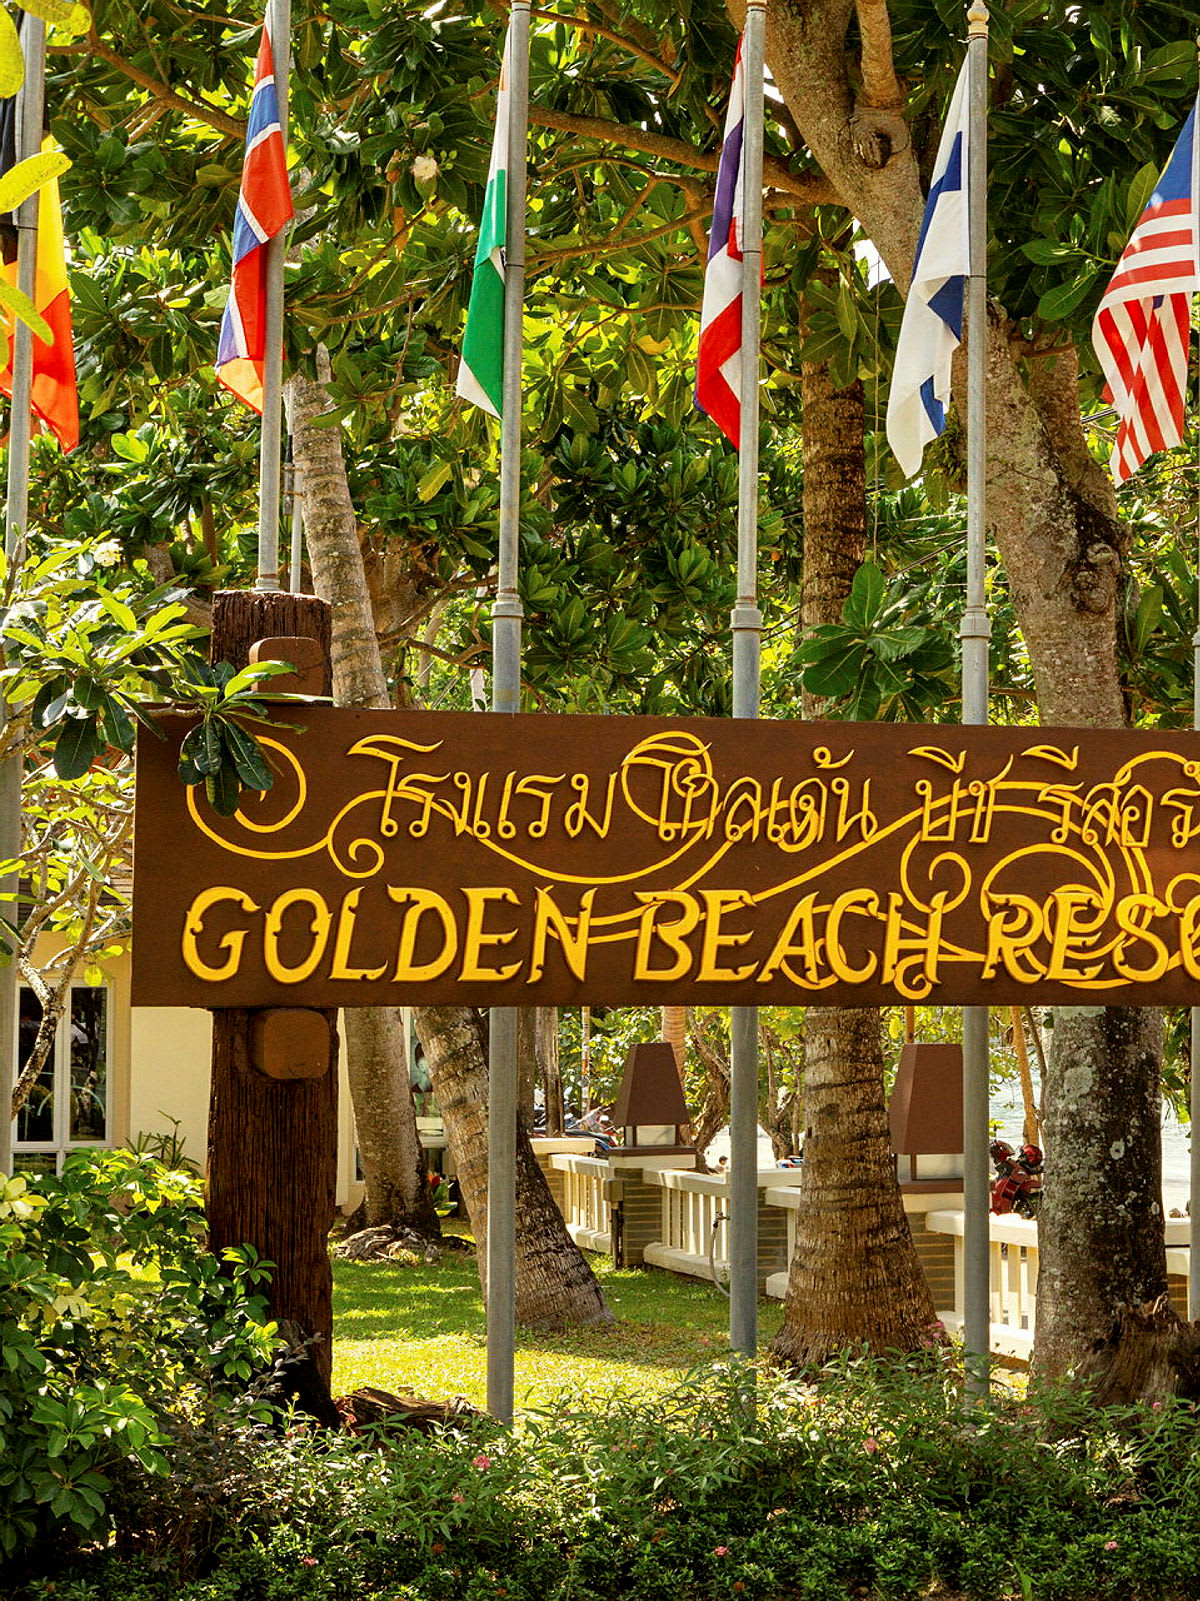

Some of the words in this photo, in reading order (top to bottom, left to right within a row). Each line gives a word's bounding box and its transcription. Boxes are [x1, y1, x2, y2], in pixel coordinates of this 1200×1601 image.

[346, 734, 619, 840] โรงแรม
[182, 884, 599, 985] GOLDEN
[633, 887, 949, 985] BEACH
